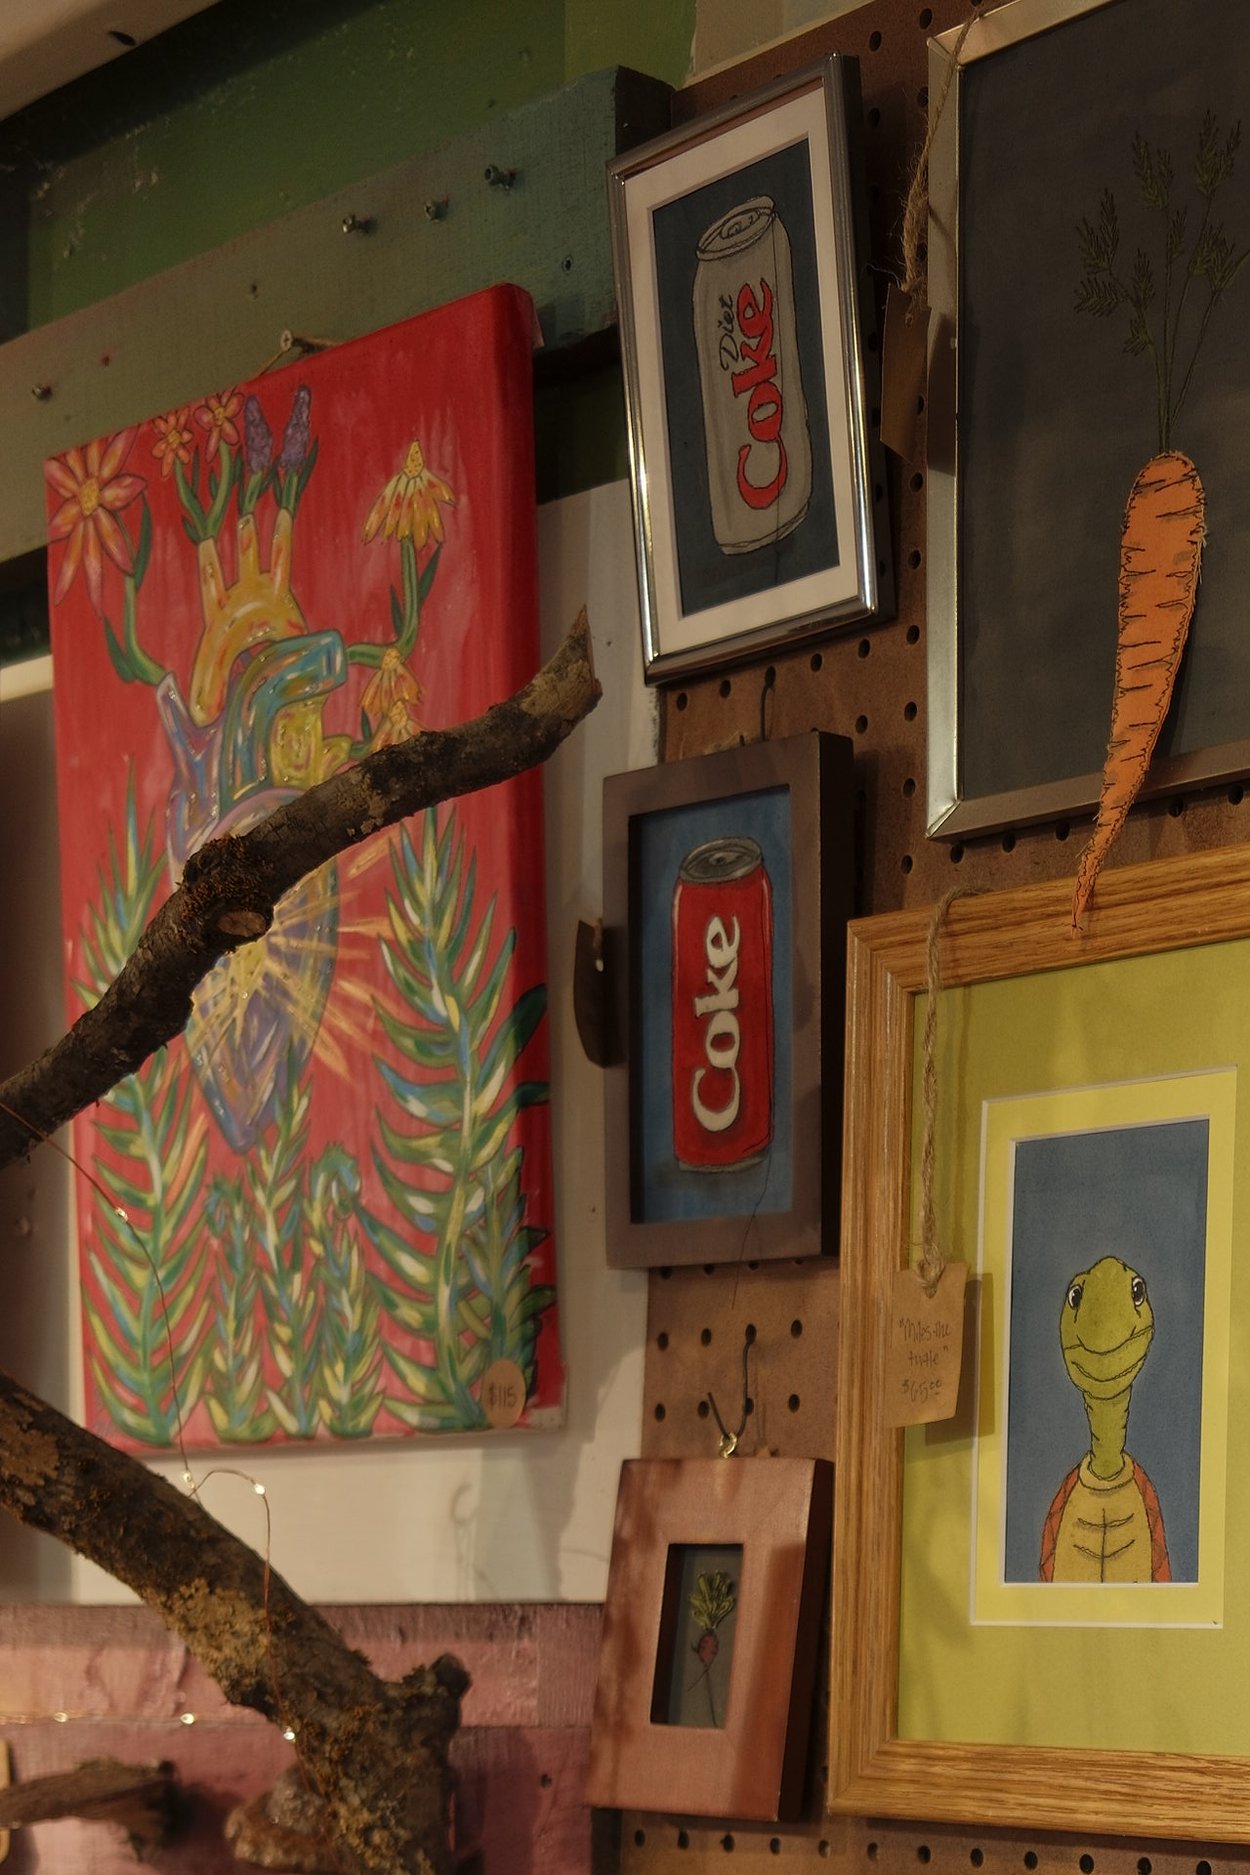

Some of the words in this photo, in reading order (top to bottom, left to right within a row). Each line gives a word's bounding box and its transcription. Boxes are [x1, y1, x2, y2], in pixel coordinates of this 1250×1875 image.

[719, 293, 740, 373] Diet
[731, 277, 788, 510] Coke
[691, 912, 740, 1132] Coke
